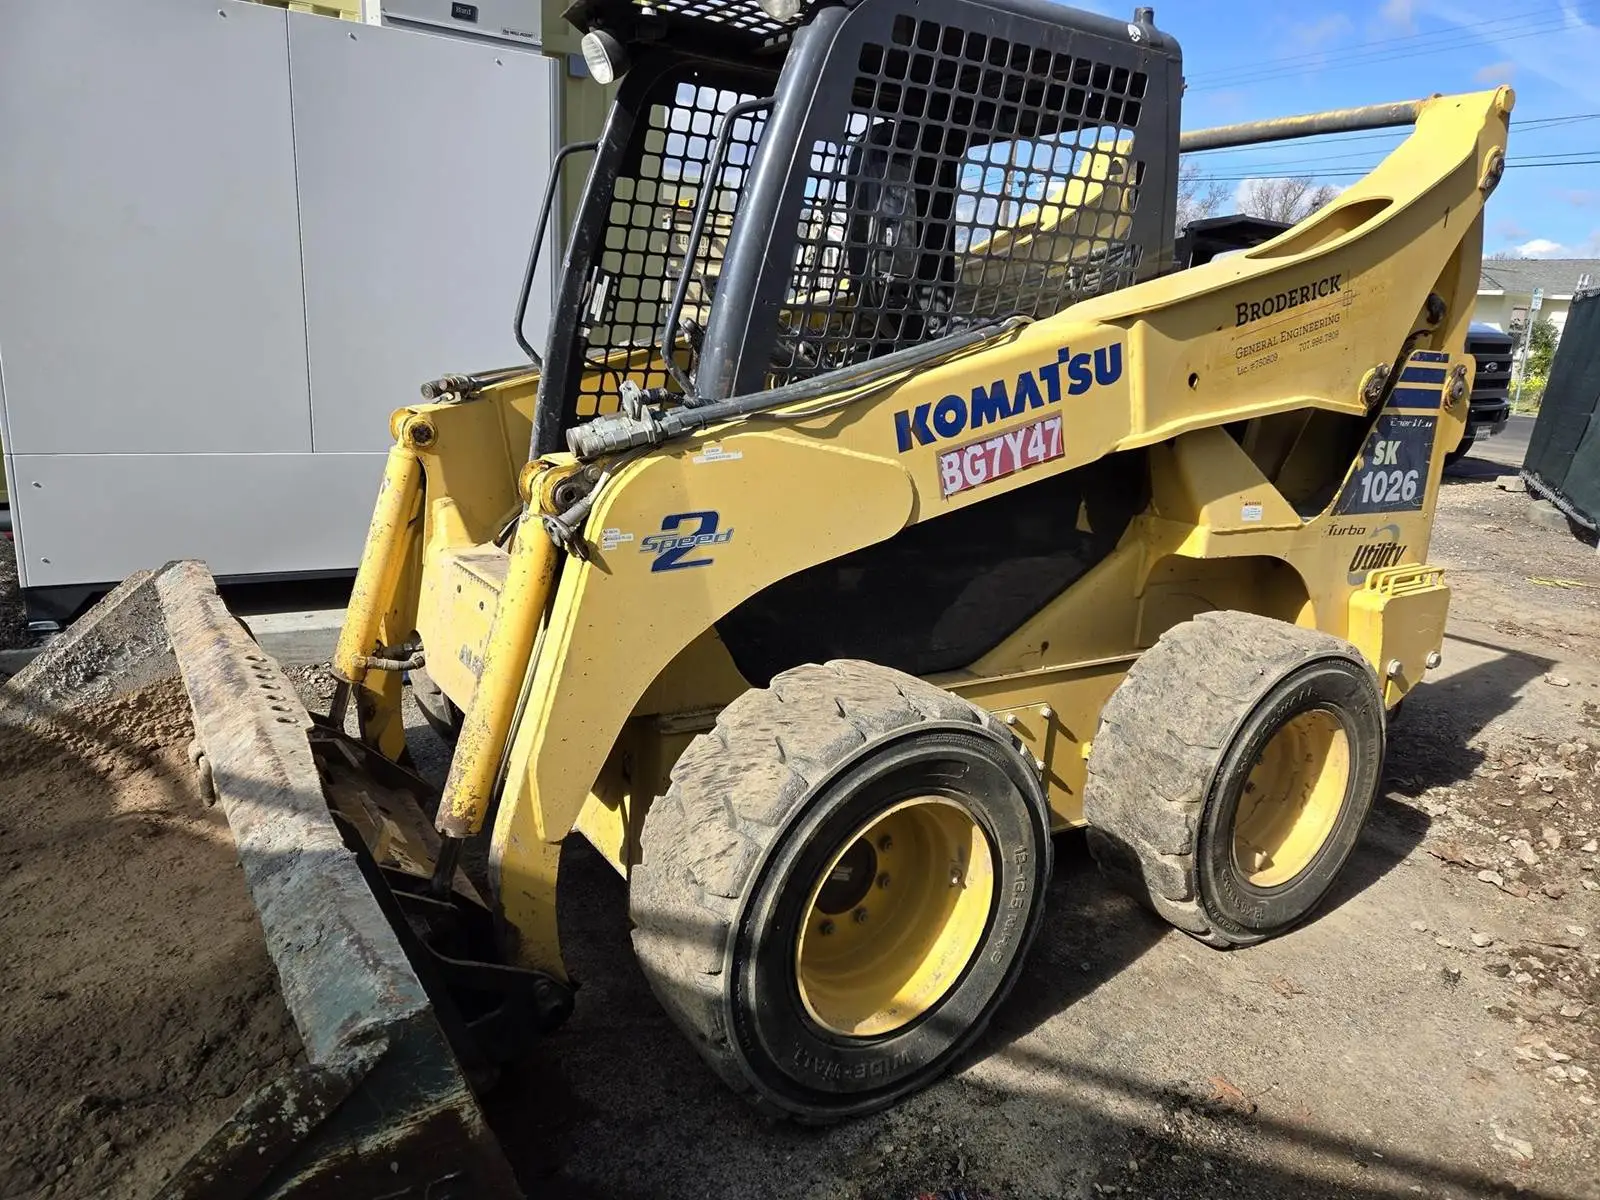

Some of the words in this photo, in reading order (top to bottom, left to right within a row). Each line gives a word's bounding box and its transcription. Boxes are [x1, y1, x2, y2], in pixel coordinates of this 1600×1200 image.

[1235, 274, 1341, 327] BRODERICK
[1235, 336, 1278, 359] GENERAL
[1280, 313, 1340, 343] ENGINEERING
[894, 343, 1122, 453] KOMATSU
[940, 417, 1064, 494] BG7Y47
[1372, 441, 1400, 465] SK
[1362, 470, 1418, 503] 1026
[651, 511, 719, 572] 2
[1327, 524, 1366, 536] Turbo
[1350, 542, 1407, 572] Utility
